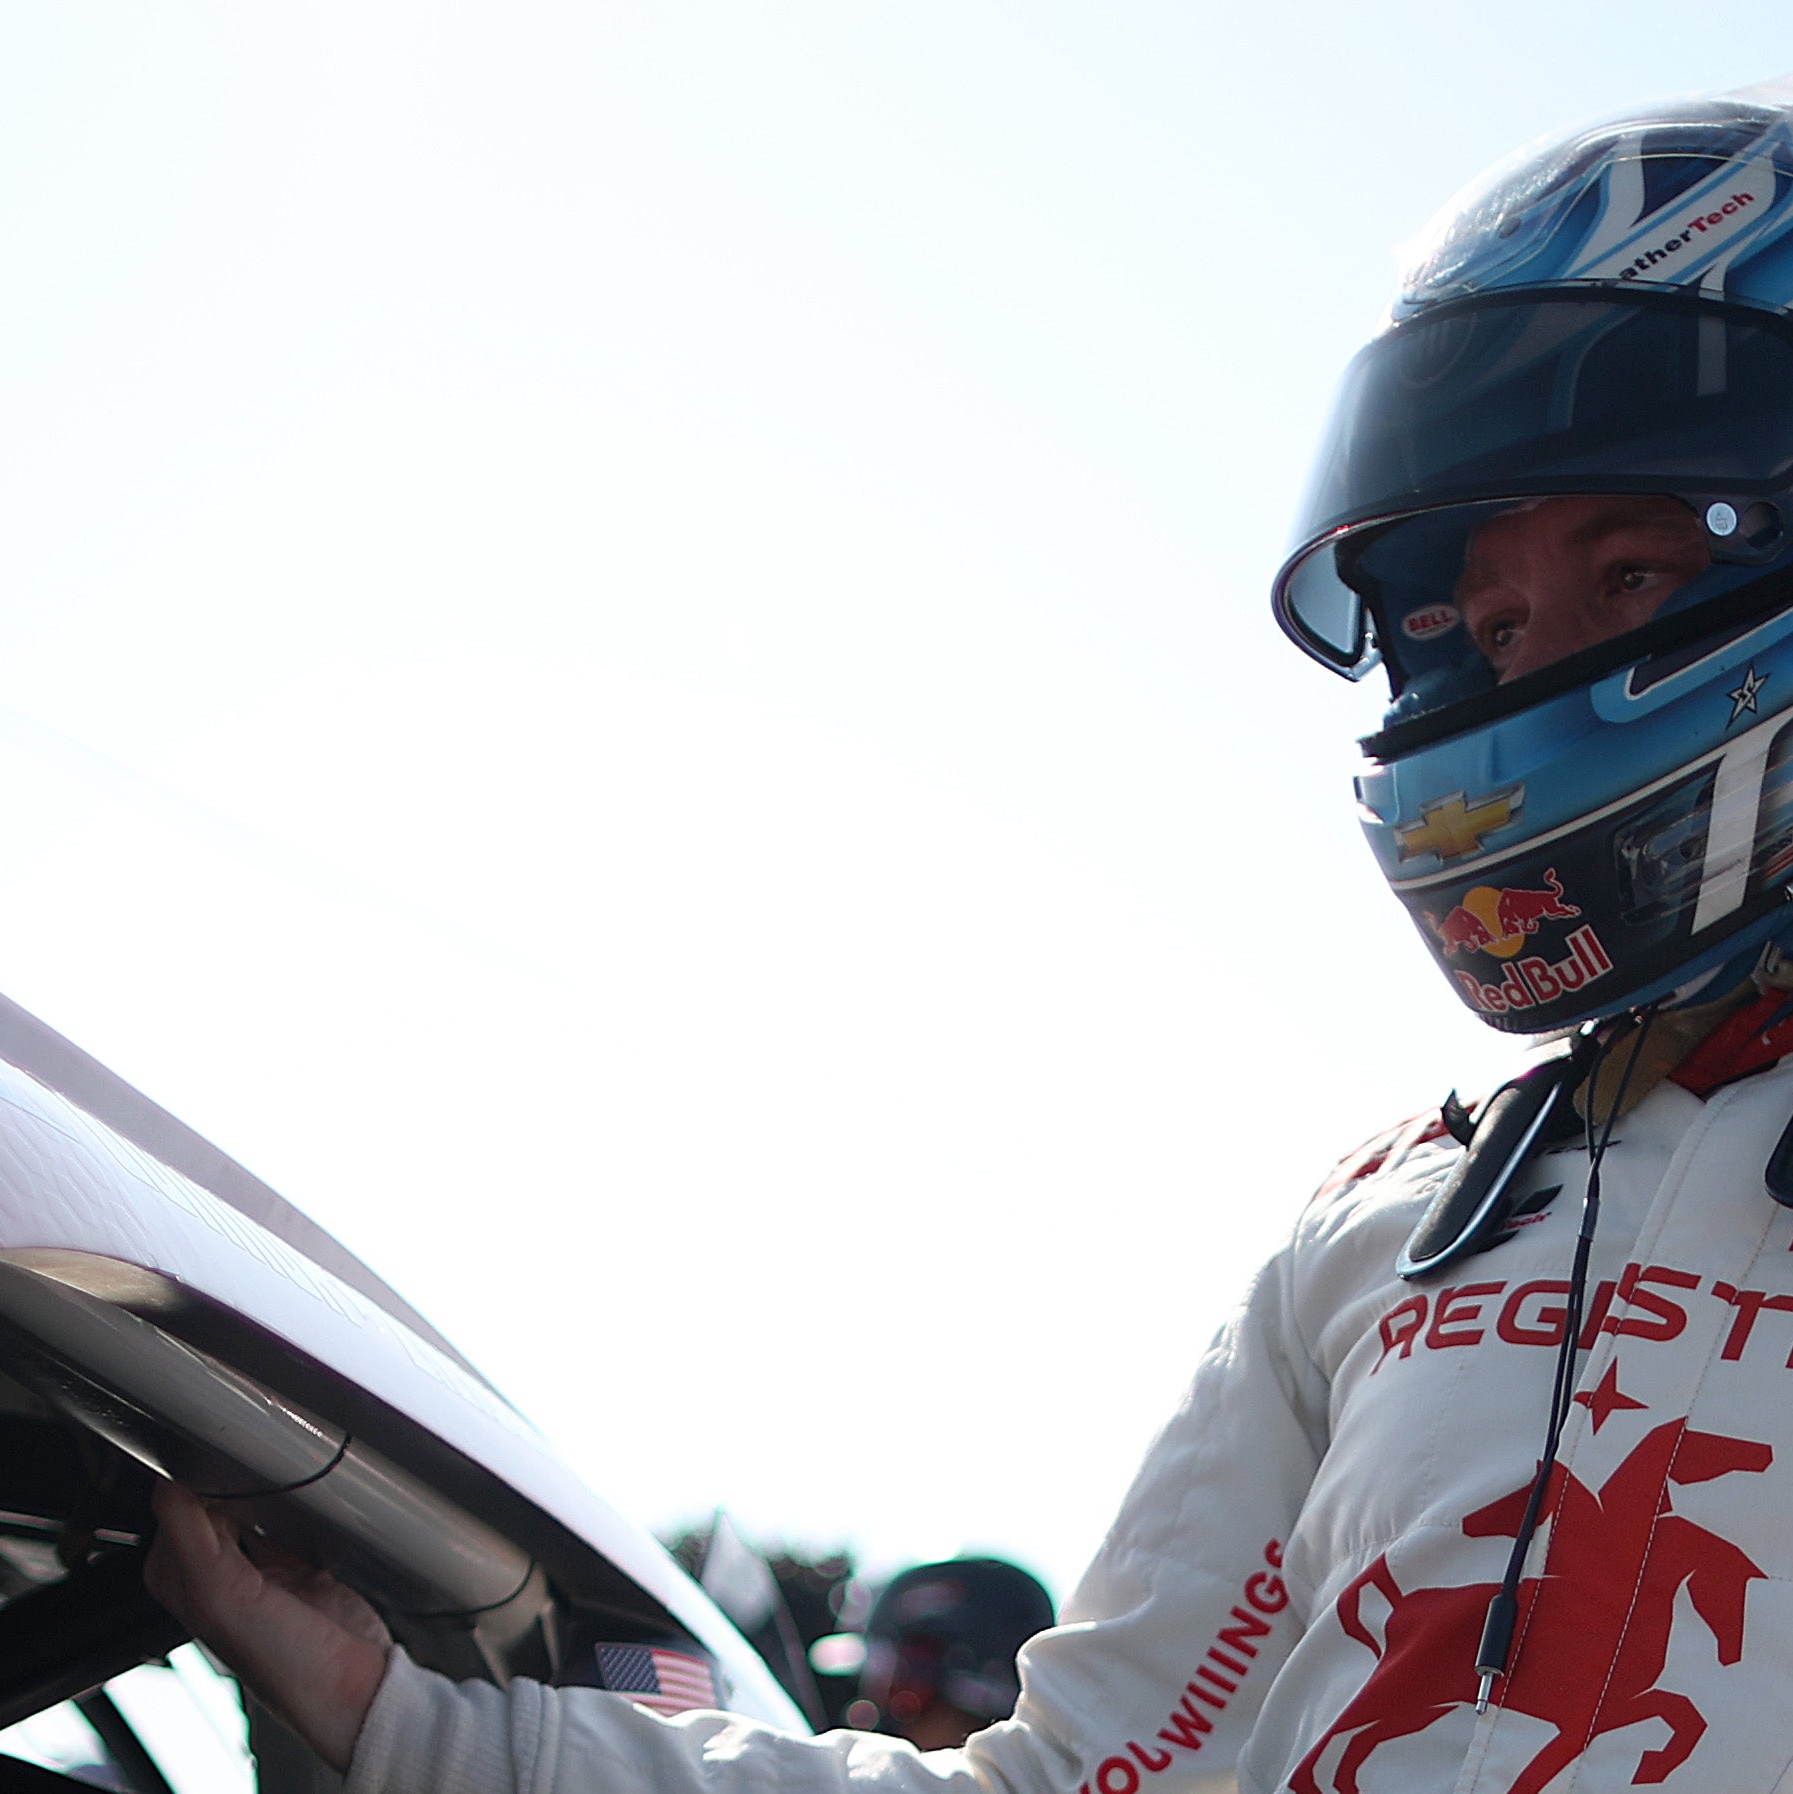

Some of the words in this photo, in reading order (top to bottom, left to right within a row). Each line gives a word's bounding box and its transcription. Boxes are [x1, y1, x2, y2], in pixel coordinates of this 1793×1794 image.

[1408, 609, 1454, 632] BELL
[1455, 962, 1536, 1012] Red
[1517, 924, 1614, 1004] Bull
